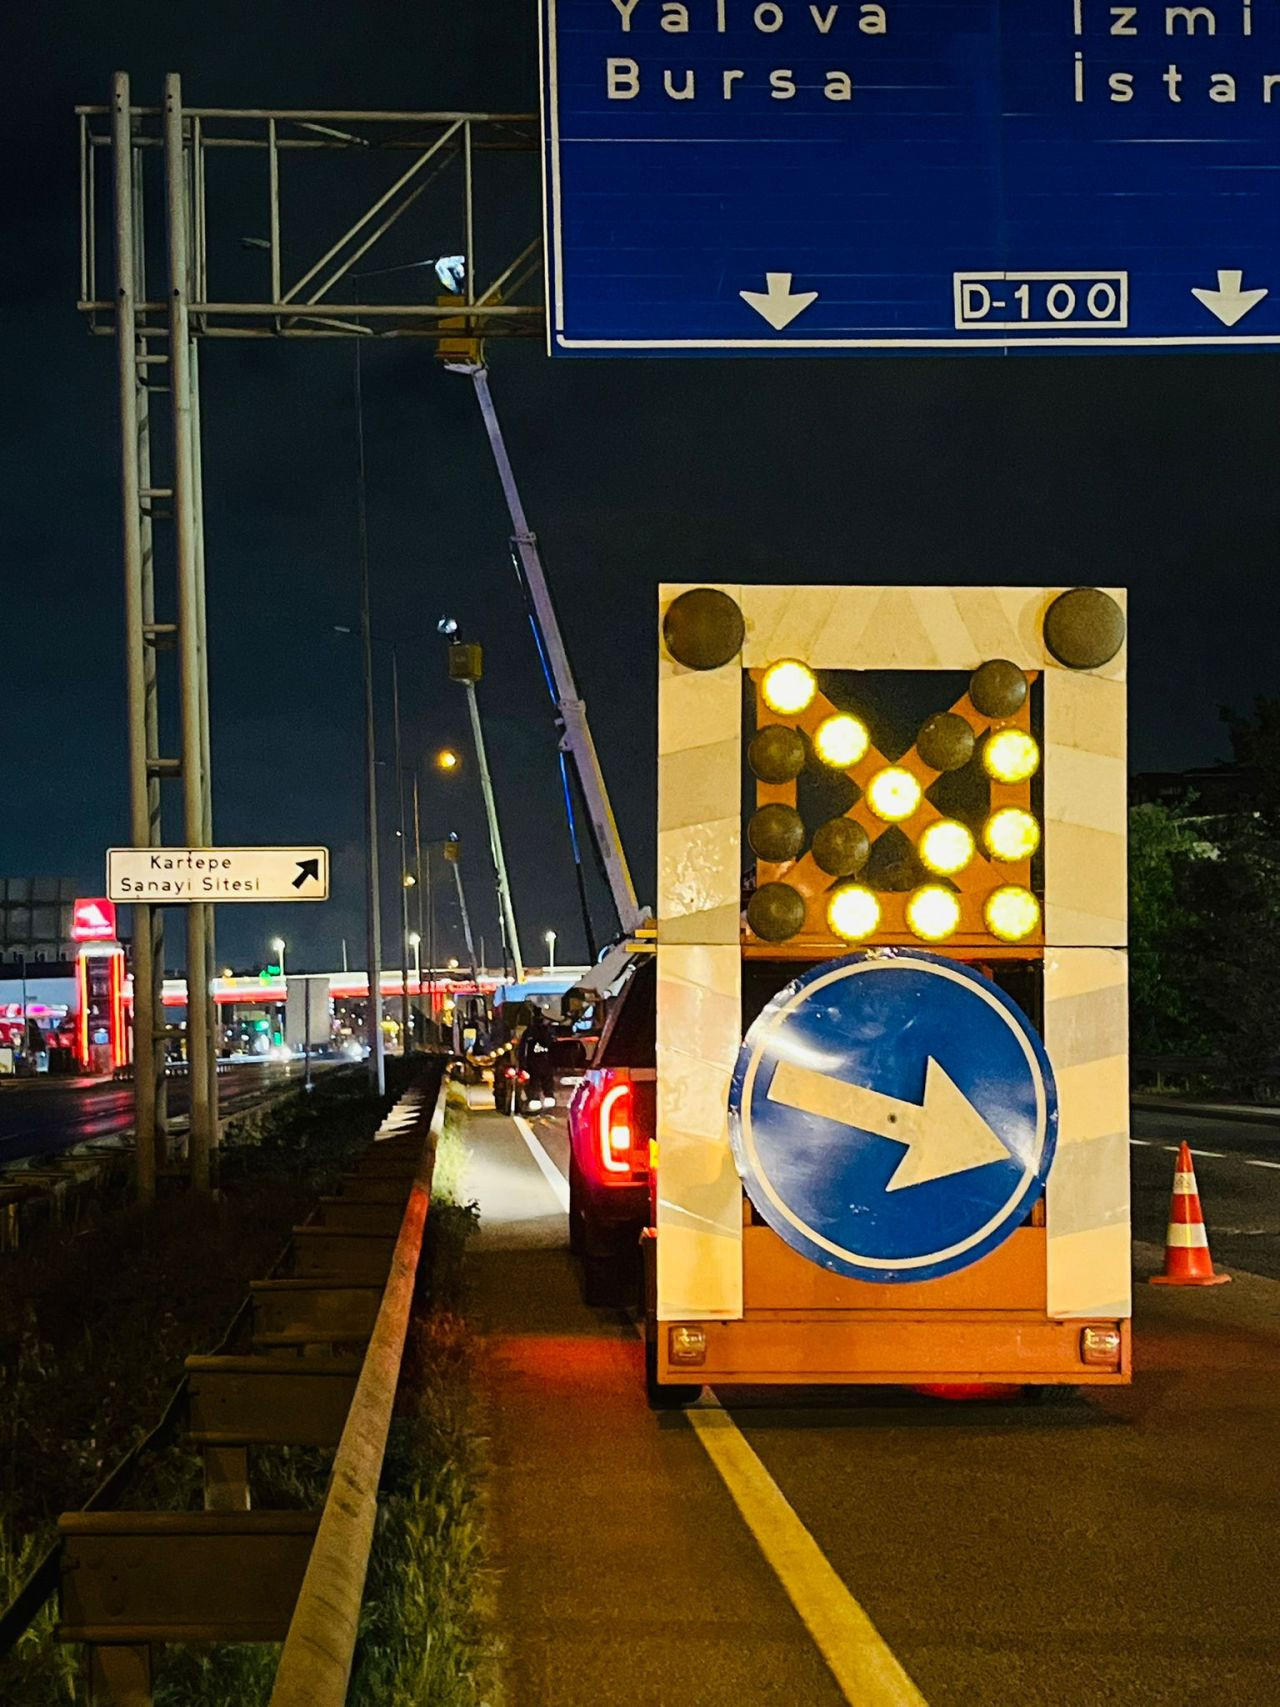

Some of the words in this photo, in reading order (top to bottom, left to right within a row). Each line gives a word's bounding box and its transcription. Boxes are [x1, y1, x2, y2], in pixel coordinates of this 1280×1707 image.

[611, 0, 886, 34] Yalova
[607, 58, 852, 101] Bursa
[962, 282, 1117, 320] D-100
[150, 855, 232, 873] Kartepe
[121, 877, 192, 895] Sanayi
[202, 876, 260, 892] Sitesi
